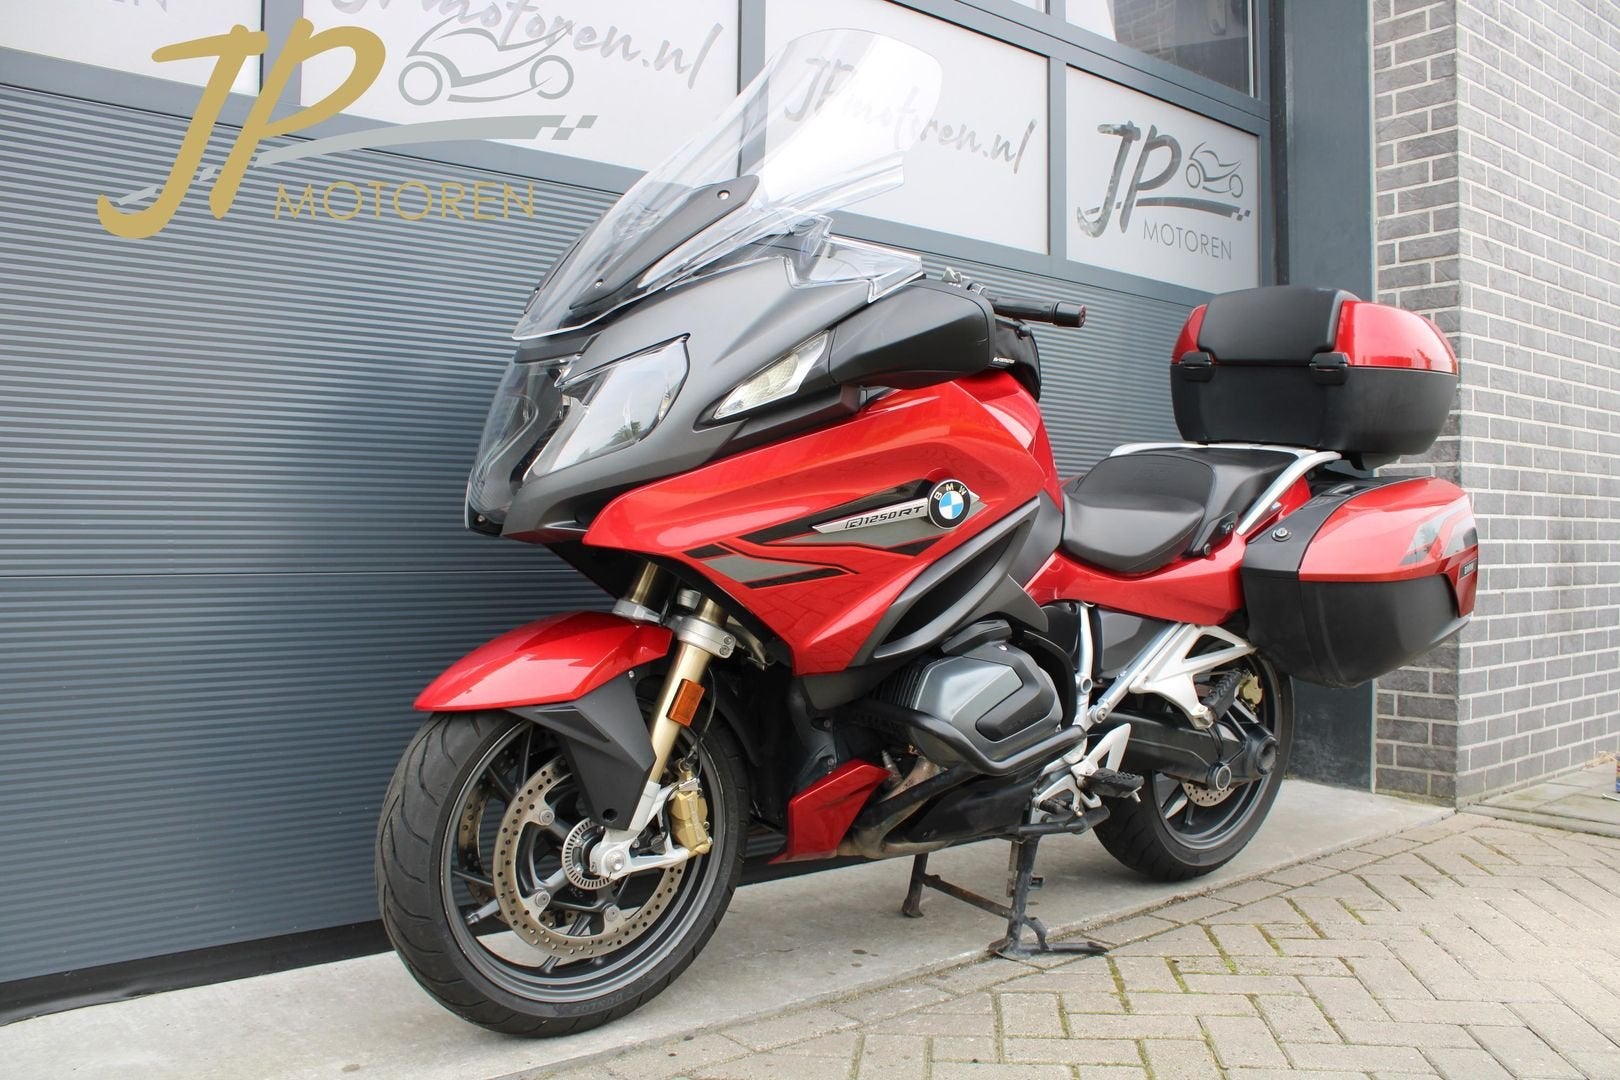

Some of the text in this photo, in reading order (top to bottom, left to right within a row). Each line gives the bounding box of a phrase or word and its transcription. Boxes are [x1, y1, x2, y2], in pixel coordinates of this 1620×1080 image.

[1076, 120, 1182, 238] JP
[1143, 218, 1232, 260] MOTOREN
[933, 482, 968, 501] BMW
